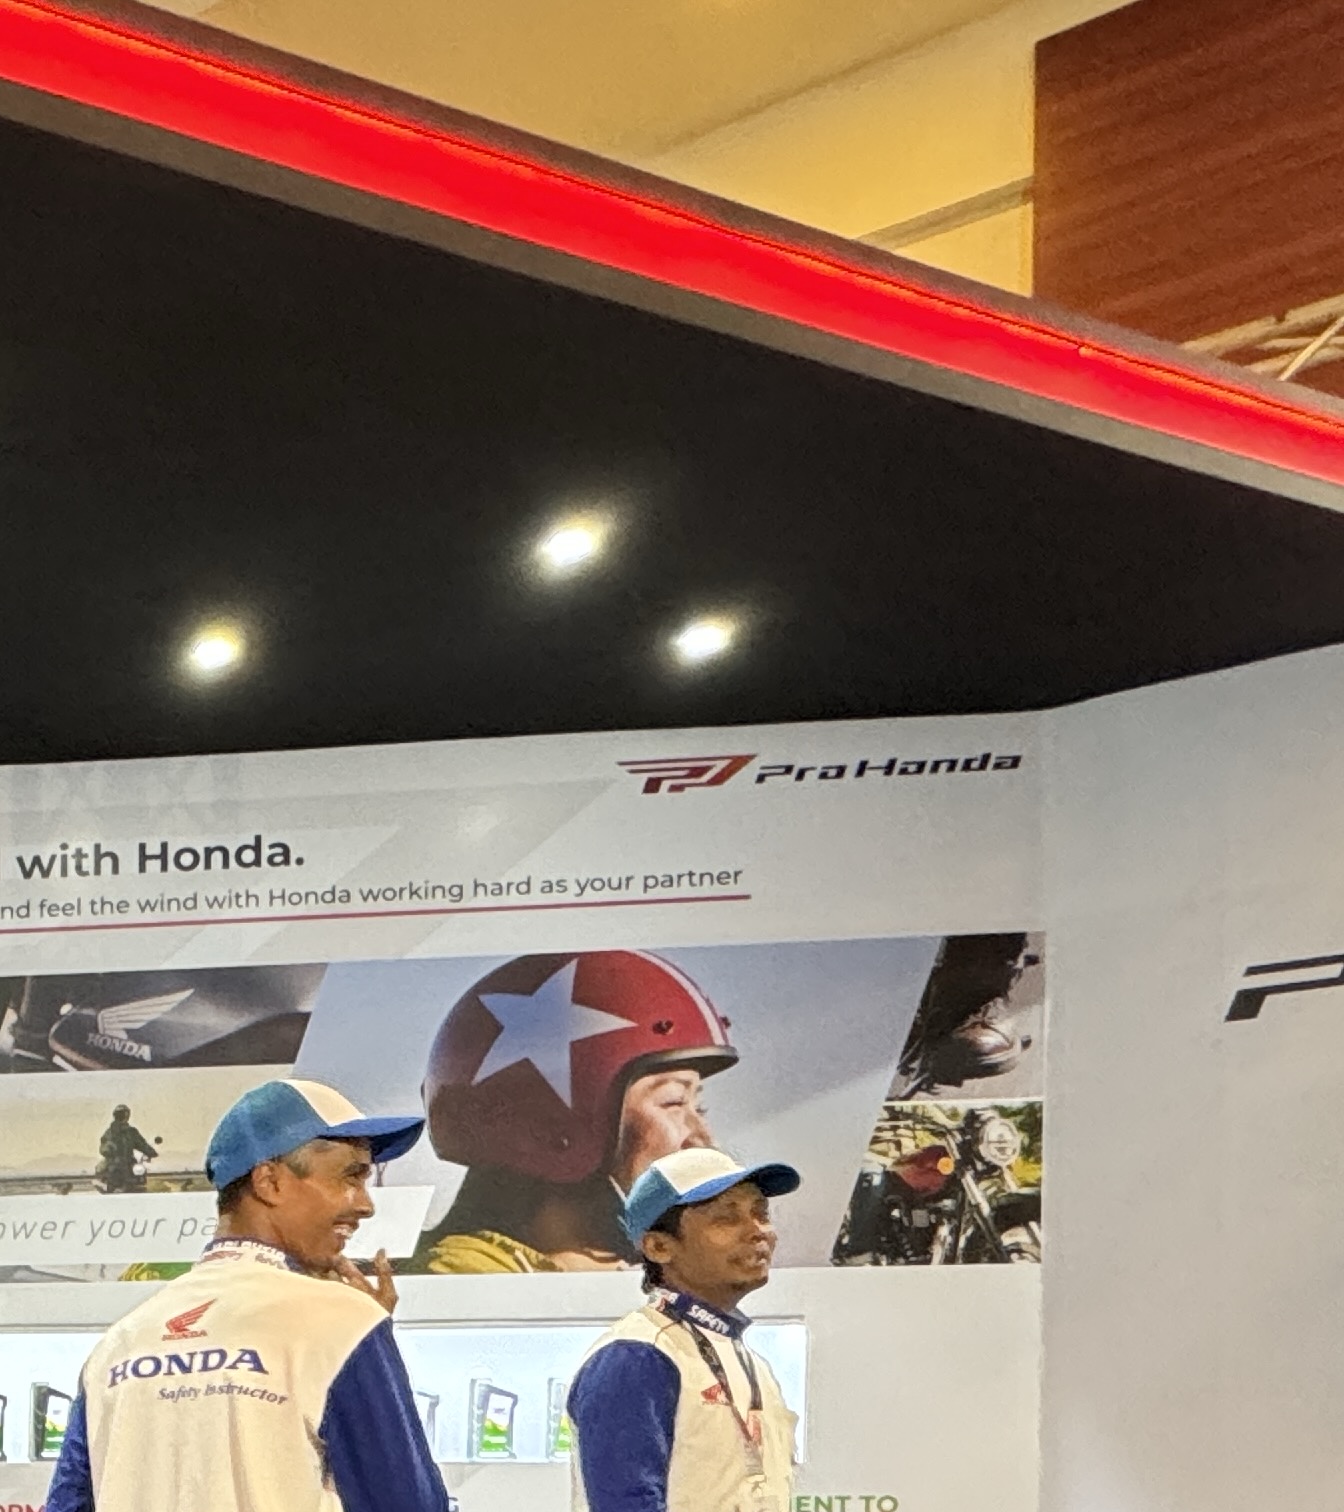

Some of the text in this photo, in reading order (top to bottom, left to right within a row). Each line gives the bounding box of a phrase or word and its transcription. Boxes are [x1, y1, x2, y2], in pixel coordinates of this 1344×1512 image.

[16, 842, 120, 880] with
[138, 835, 306, 874] Honda.
[38, 897, 82, 918] feel
[89, 895, 130, 916] the
[136, 892, 198, 914] wind
[204, 888, 260, 911] with
[268, 884, 352, 908] Honda
[358, 879, 464, 905] working
[472, 875, 531, 897] hard
[539, 877, 568, 895] as
[572, 872, 635, 898] your
[642, 866, 744, 896] partner
[87, 1031, 153, 1062] HONDA
[86, 1216, 168, 1246] your
[177, 1213, 219, 1243] pa
[107, 1348, 270, 1389] HONDA
[158, 1382, 288, 1405] Safety Instructor
